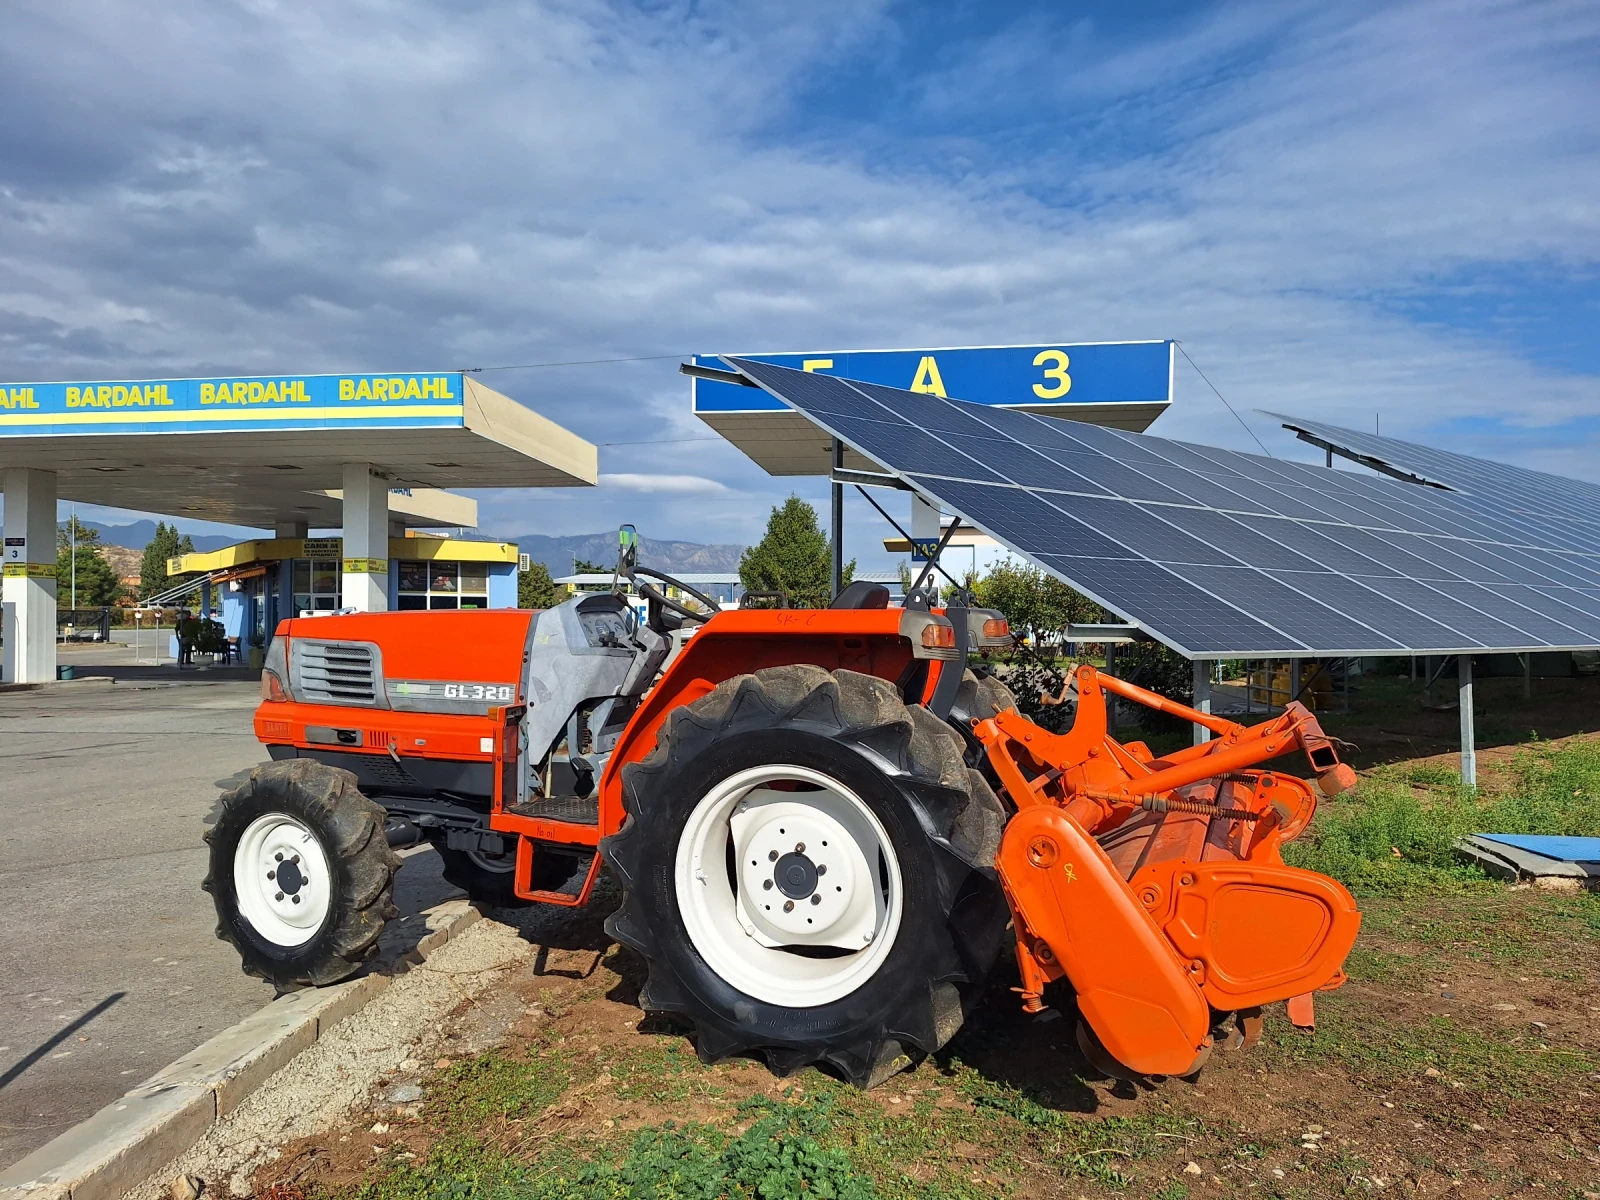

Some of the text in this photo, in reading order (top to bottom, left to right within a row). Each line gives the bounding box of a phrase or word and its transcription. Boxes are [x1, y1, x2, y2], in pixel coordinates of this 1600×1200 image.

[66, 385, 173, 408] BARDAHL
[201, 381, 311, 405] BARDAHL
[339, 378, 454, 401] BARDAHL
[12, 550, 18, 558] 3
[444, 685, 510, 700] GL320
